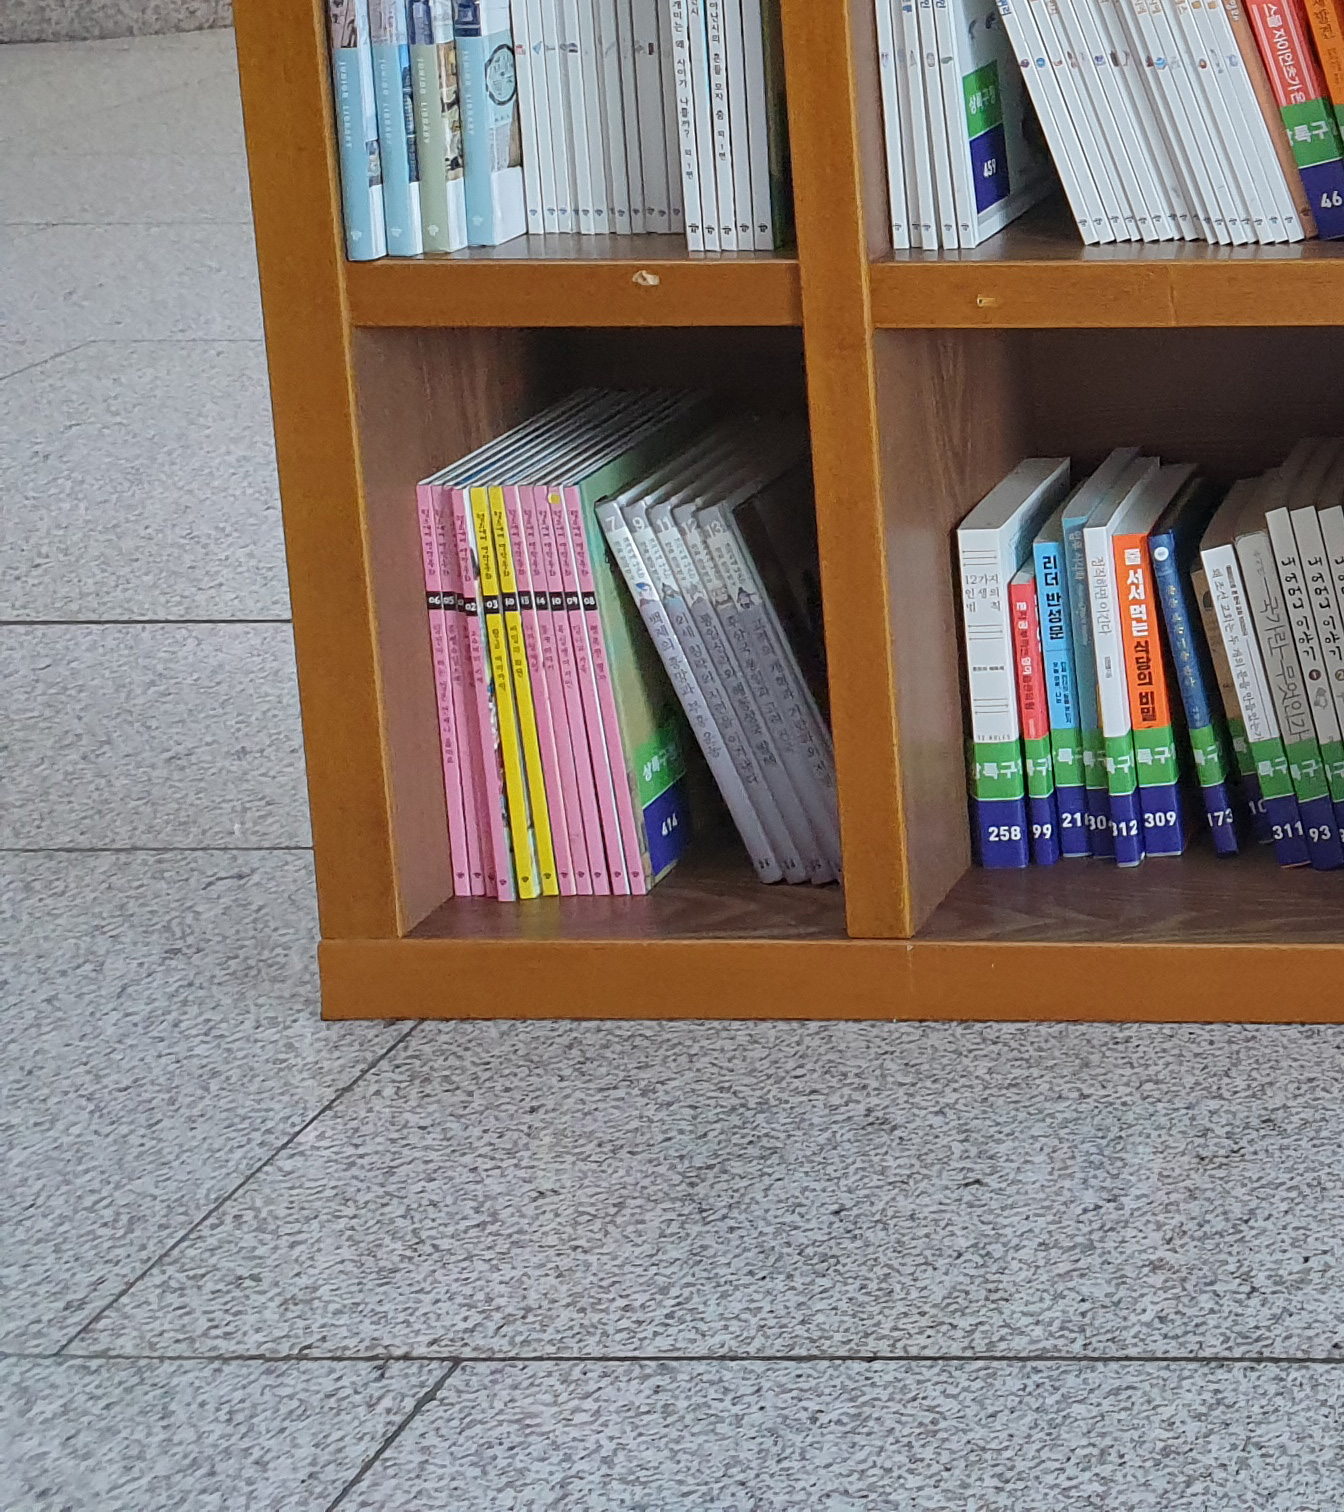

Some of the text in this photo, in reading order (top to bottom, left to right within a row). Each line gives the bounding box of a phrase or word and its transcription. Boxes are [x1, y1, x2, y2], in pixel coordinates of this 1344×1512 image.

[1320, 191, 1343, 208] 46
[606, 515, 618, 532] 7
[632, 515, 645, 530] 9
[655, 515, 671, 531] 11
[703, 520, 722, 536] 13
[965, 574, 999, 585] 12가지
[965, 588, 1000, 600] 인생의
[1042, 555, 1064, 640] 리더 반성문
[1145, 811, 1176, 828] 309
[988, 826, 1021, 841] 258
[1032, 824, 1052, 839] 99
[1272, 821, 1303, 841] 311
[1310, 826, 1331, 842] 93
